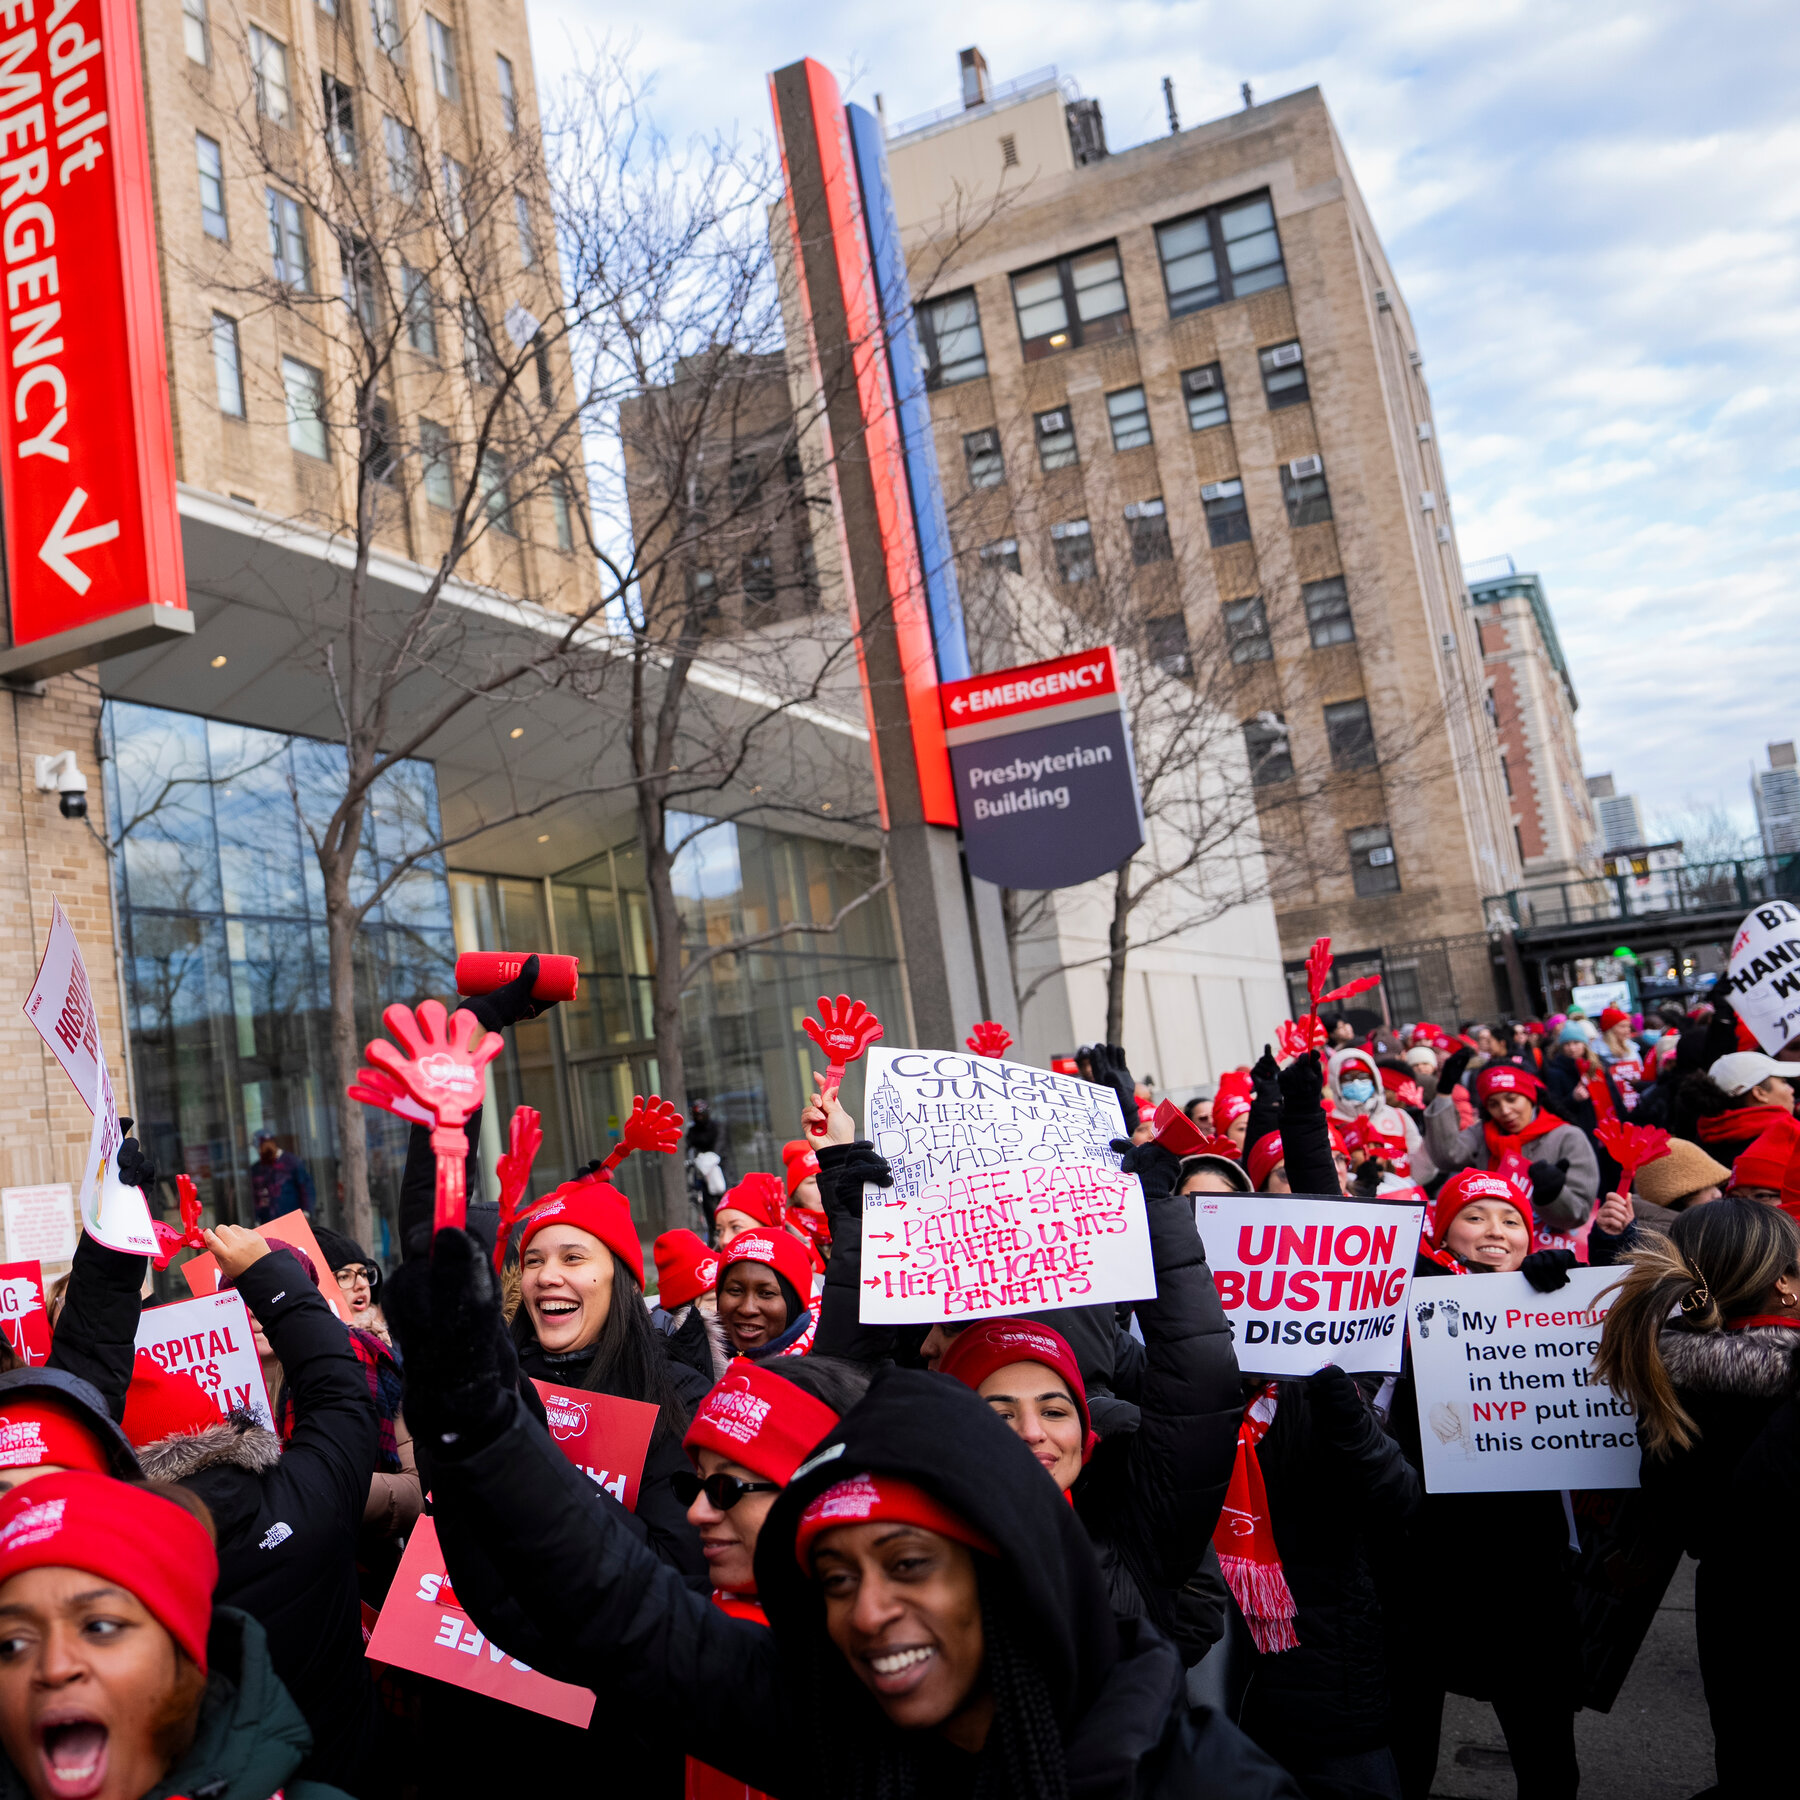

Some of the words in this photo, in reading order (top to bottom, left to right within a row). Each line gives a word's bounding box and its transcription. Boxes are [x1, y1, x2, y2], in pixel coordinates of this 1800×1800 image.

[968, 661, 1106, 713] EMERGENCY
[969, 744, 1112, 790] Presbyterian
[974, 785, 1070, 821] Building
[891, 1055, 1116, 1106] CONCRETE
[890, 1103, 998, 1125] WHERE
[877, 1122, 1023, 1159] DREAMS
[1041, 1123, 1110, 1146] ARE
[926, 1144, 1023, 1178] MADE
[917, 1171, 1014, 1215] SAFE
[1022, 1165, 1138, 1194] RATIOS
[904, 1197, 1023, 1246] PATIENT
[1029, 1187, 1129, 1214] SAFETY
[912, 1228, 1033, 1269] STAFFED
[1038, 1211, 1128, 1245] UNITS
[1237, 1225, 1398, 1267] UNION
[1533, 1231, 1577, 1254] ORK
[884, 1241, 1094, 1299] HEALTHCARE
[944, 1271, 1092, 1316] BENEFITS
[1213, 1267, 1408, 1313] BUSTING
[1245, 1313, 1397, 1346] DISGUSTING
[1462, 1311, 1497, 1335] My
[1466, 1342, 1527, 1361] have
[1535, 1340, 1600, 1359] more
[1469, 1373, 1492, 1392] in
[1499, 1371, 1565, 1390] them
[711, 1391, 768, 1423] NURSES
[1473, 1401, 1527, 1422] NYP
[1535, 1399, 1580, 1424] put
[1585, 1398, 1635, 1418] into
[1475, 1432, 1523, 1452] this
[1531, 1429, 1638, 1451] contrac
[258, 1531, 283, 1550] NORTH
[264, 1525, 278, 1537] THE
[268, 1535, 285, 1550] FACE
